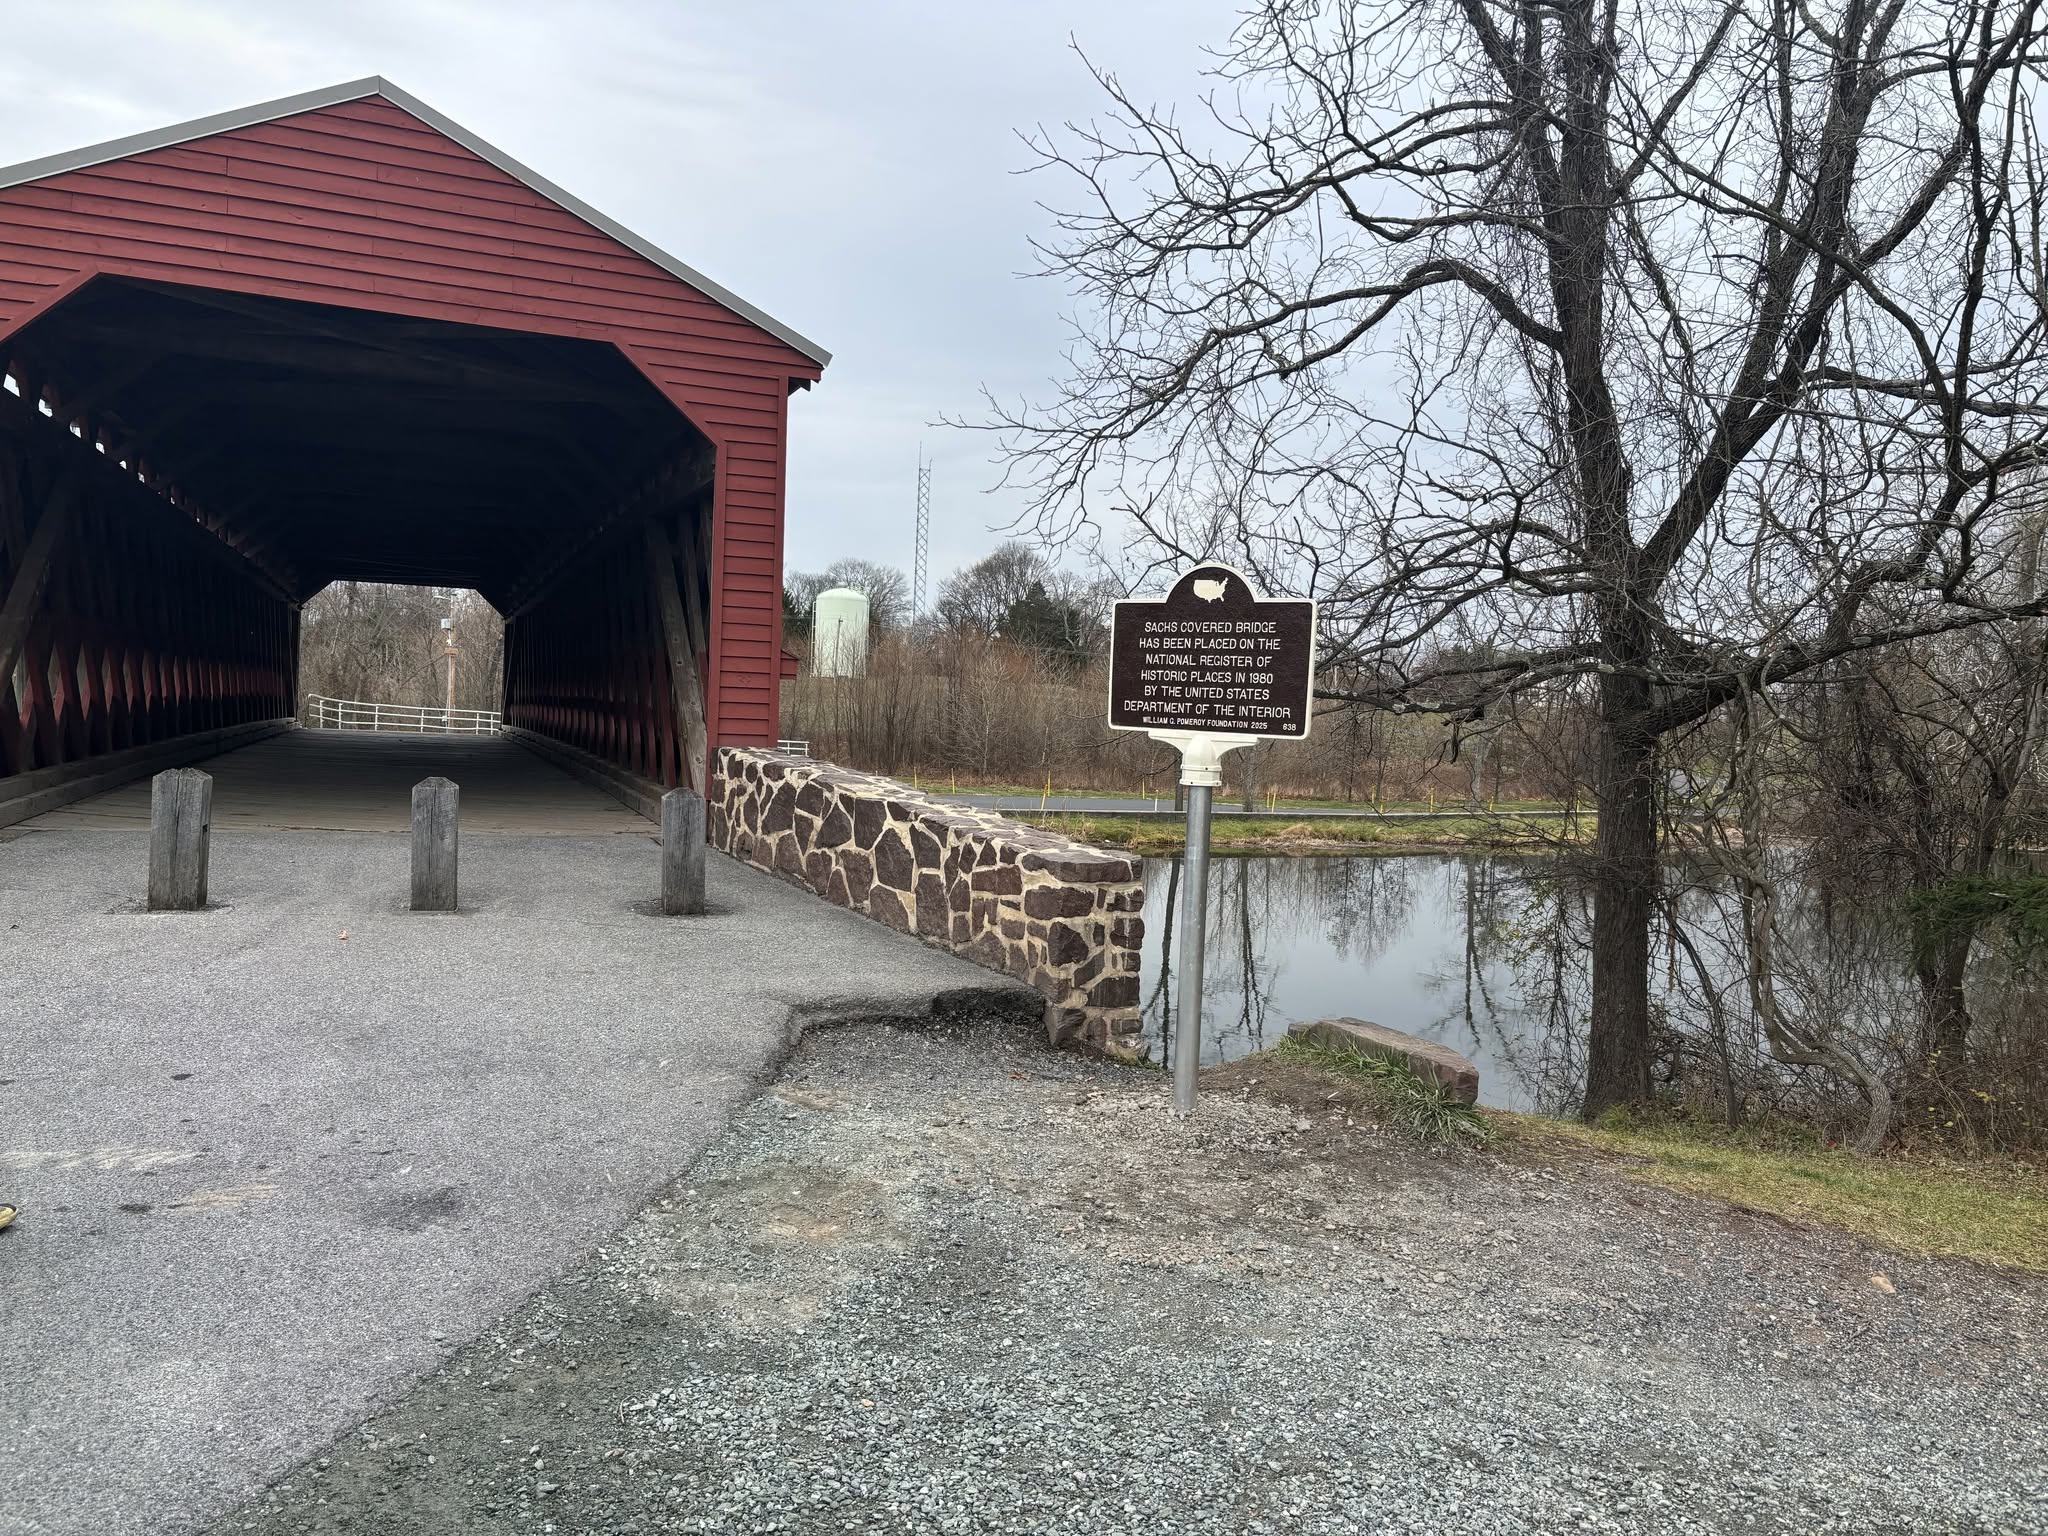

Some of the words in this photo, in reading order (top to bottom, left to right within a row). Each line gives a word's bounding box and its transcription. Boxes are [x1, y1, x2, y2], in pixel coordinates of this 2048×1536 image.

[1144, 622, 1178, 632] SACHS
[1180, 622, 1232, 633] COVERED
[1236, 622, 1276, 633] BRIDGE
[1140, 638, 1160, 648] HAS
[1164, 638, 1191, 649] BEEN
[1194, 638, 1236, 649] PLACED
[1240, 638, 1254, 649] ON
[1258, 639, 1280, 650] THE
[1146, 654, 1196, 666] NATIONAL
[1200, 656, 1252, 667] REGISTER
[1256, 656, 1272, 667] OF
[1141, 670, 1187, 681] HISTORIC
[1191, 672, 1232, 683] PLACES
[1235, 672, 1246, 683] IN
[1249, 673, 1273, 684] 1980
[1144, 685, 1158, 696] BY
[1161, 686, 1182, 697] THE
[1185, 687, 1224, 699] UNITED
[1226, 688, 1270, 700] STATES
[1124, 700, 1192, 714] DEPARTMENT
[1196, 704, 1209, 714] OF
[1214, 704, 1235, 716] THE
[1239, 706, 1290, 718] INTERIOR
[1207, 720, 1248, 728] FOUNDATION
